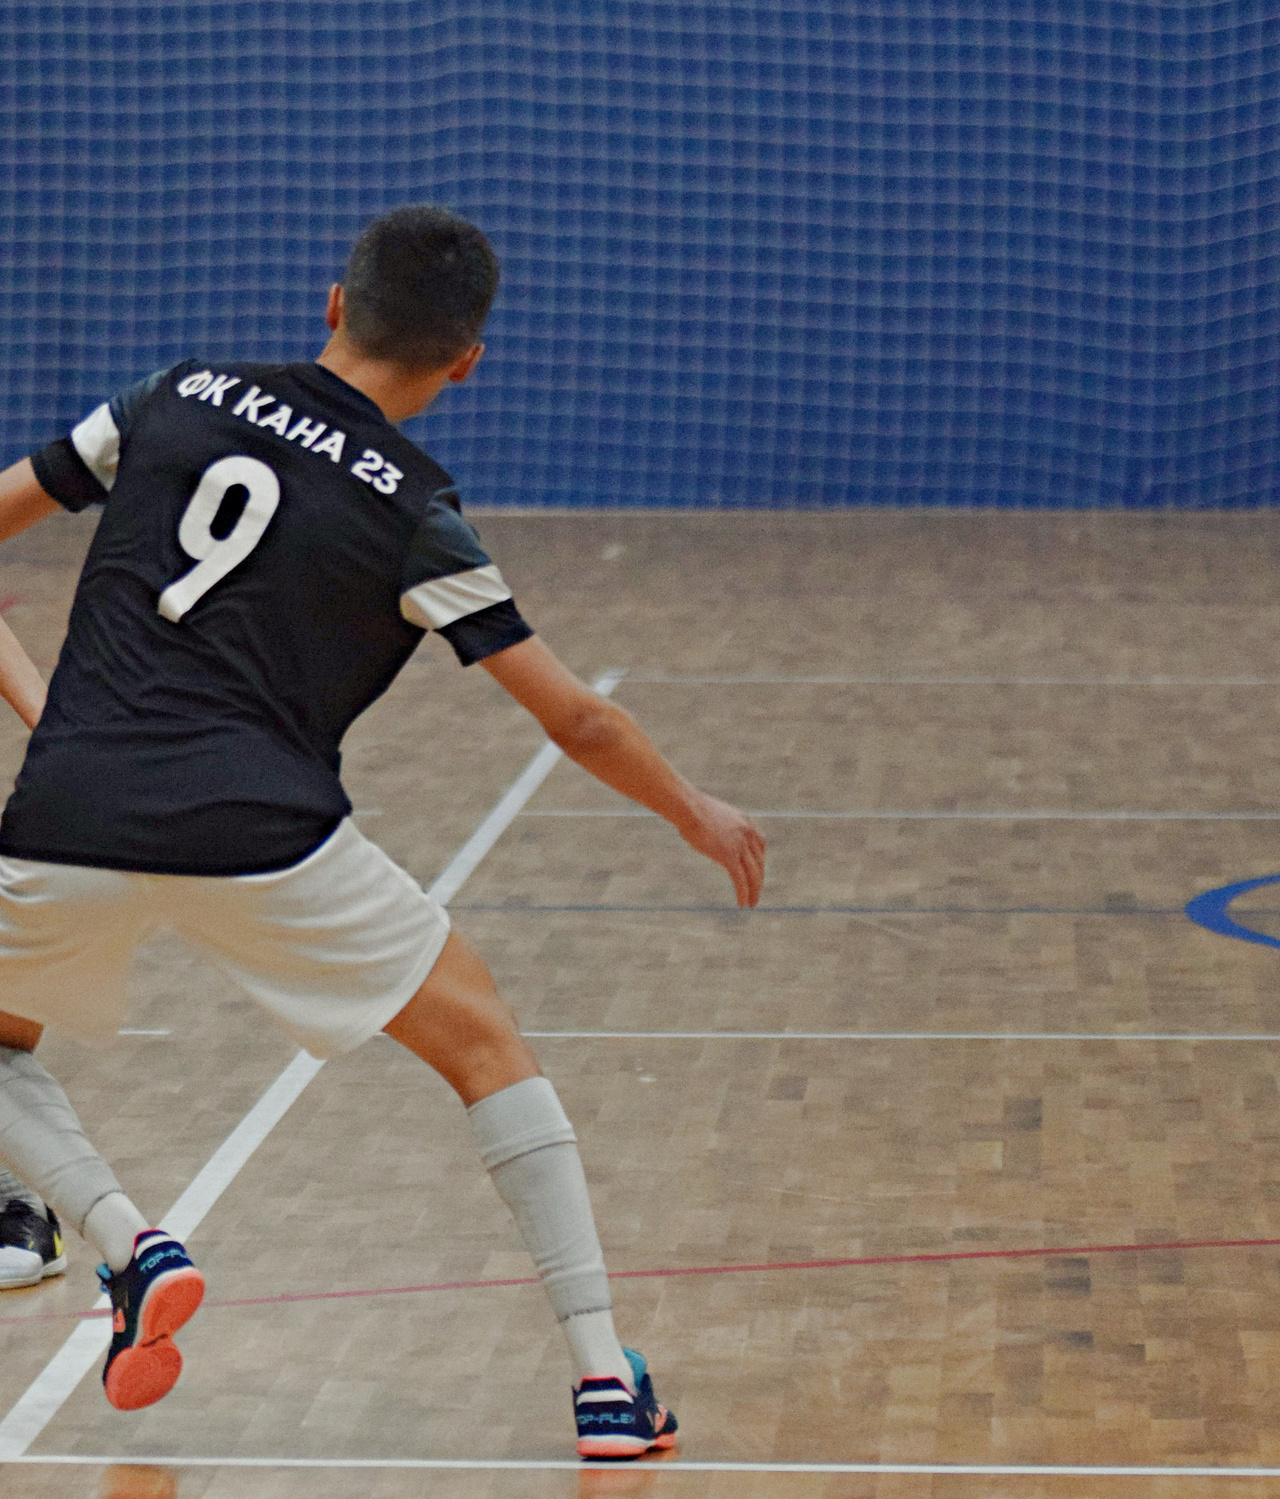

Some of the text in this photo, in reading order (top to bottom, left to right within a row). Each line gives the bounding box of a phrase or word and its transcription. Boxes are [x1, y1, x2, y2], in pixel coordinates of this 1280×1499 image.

[176, 369, 405, 495] ФК КАНА 23
[157, 454, 281, 624] 9
